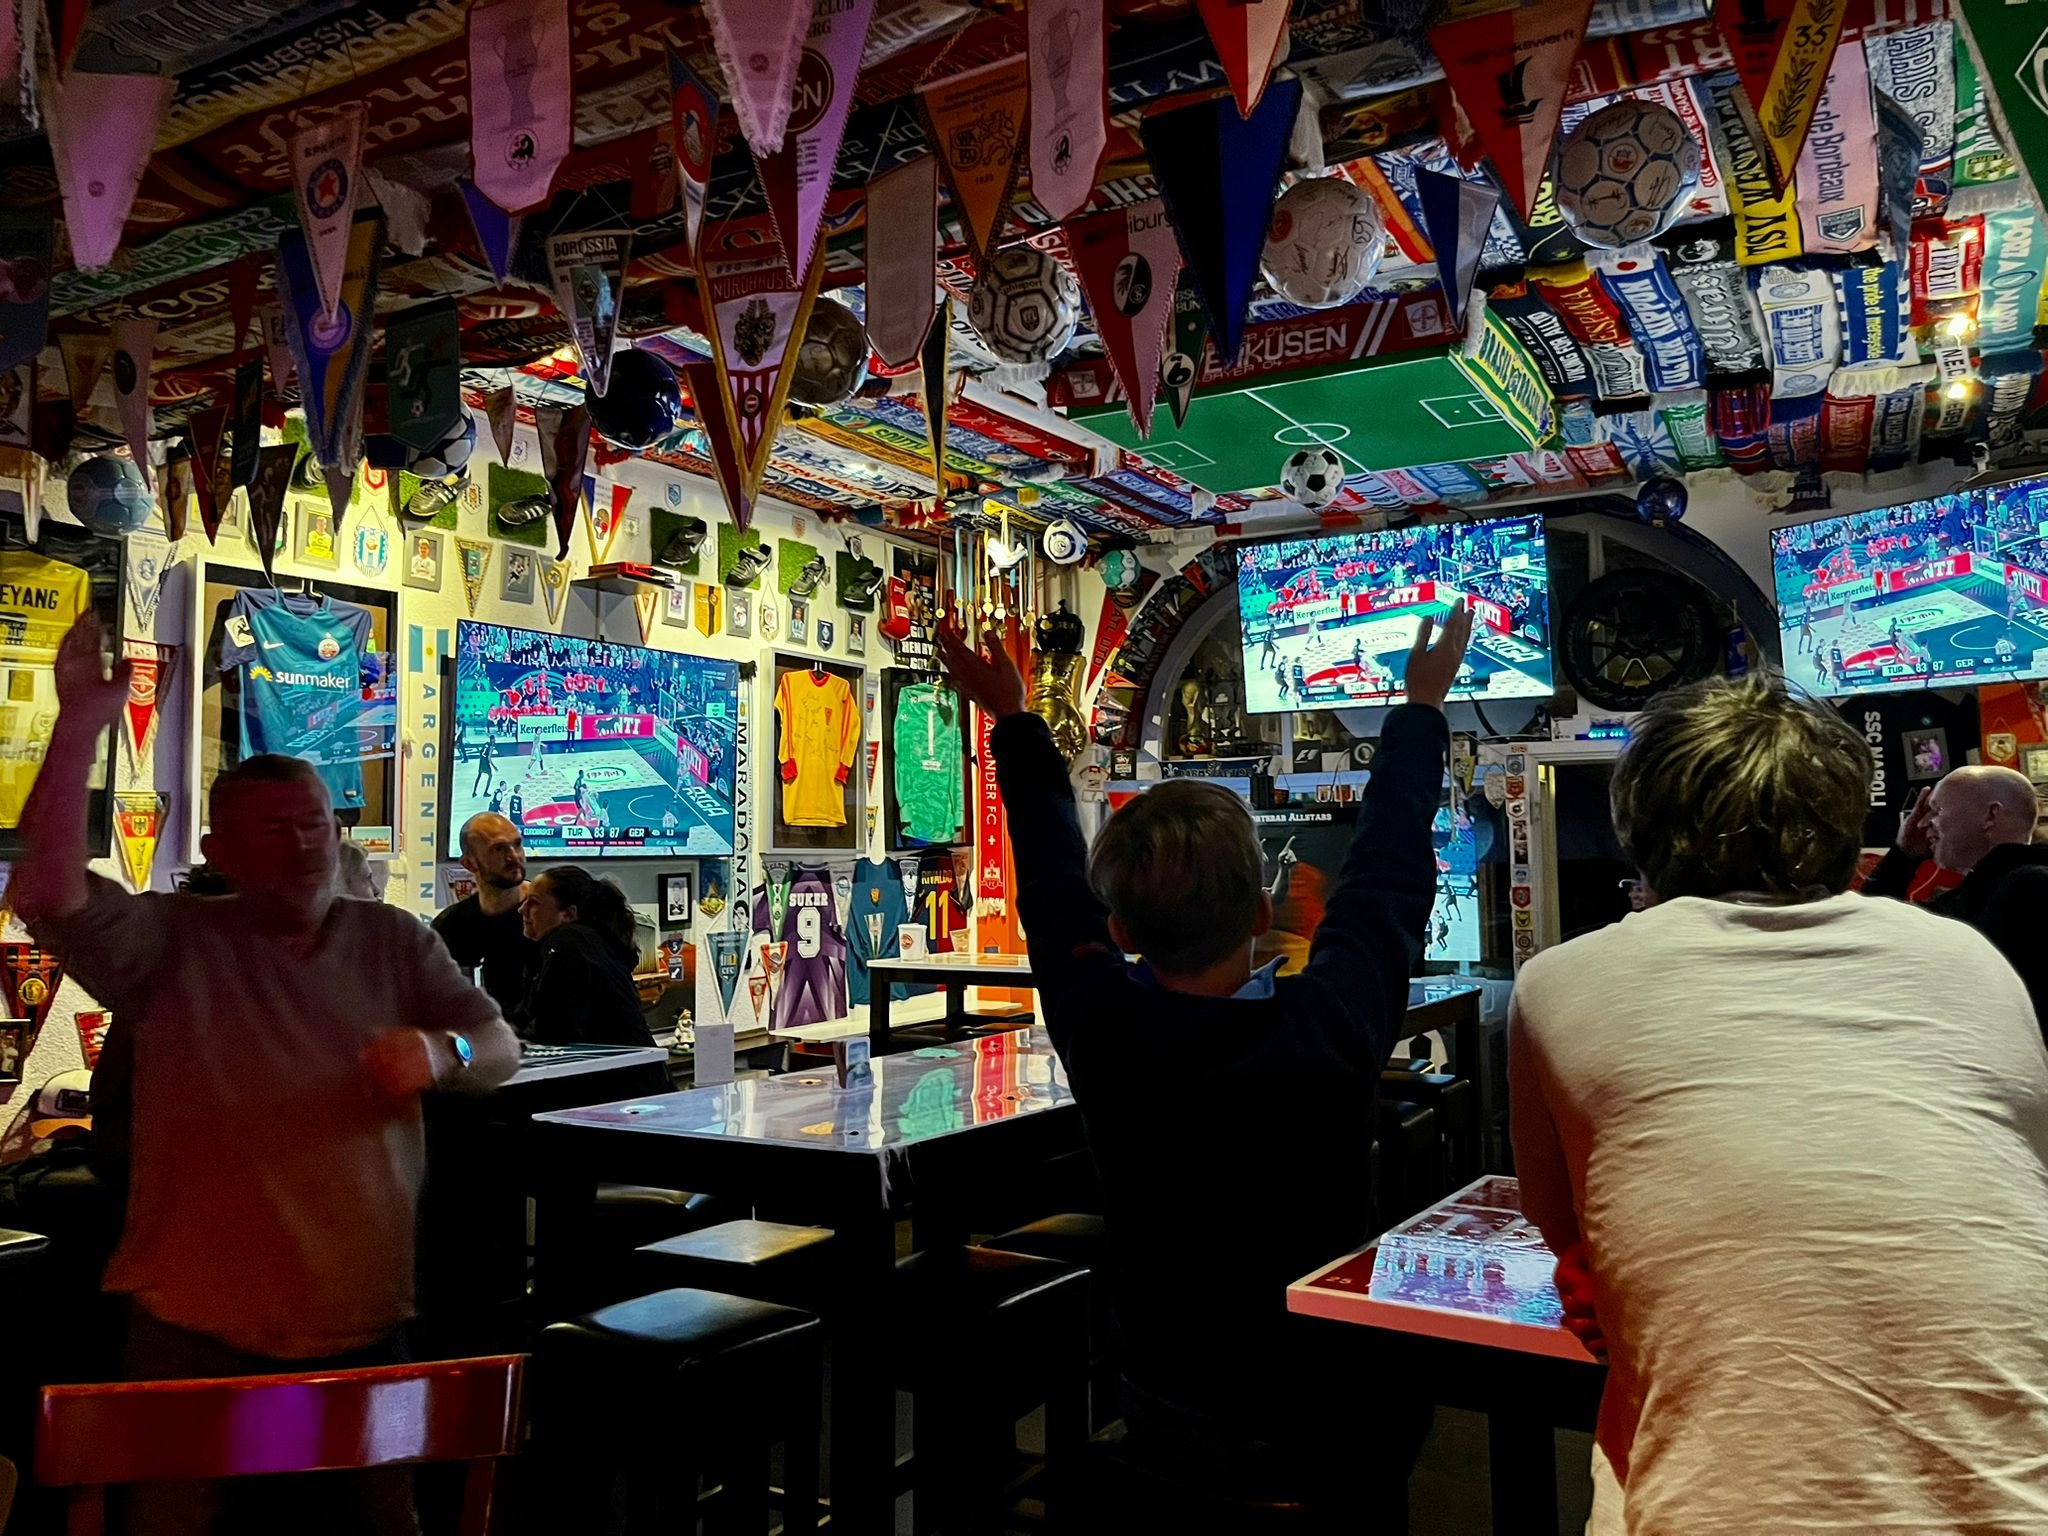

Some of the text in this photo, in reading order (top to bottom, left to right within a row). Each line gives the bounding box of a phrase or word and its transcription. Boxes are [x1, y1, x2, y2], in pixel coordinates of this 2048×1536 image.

[1811, 134, 1846, 204] Bordeaux
[554, 236, 618, 258] BORUSSIA
[1746, 213, 1788, 258] TSV
[1862, 265, 1885, 283] the
[1617, 278, 1674, 340] NIPPON
[1858, 284, 1885, 310] pride
[1548, 335, 1576, 356] FOR
[1864, 318, 1885, 360] merseyside
[1559, 353, 1588, 383] VIKING
[1652, 337, 1695, 384] ULTRA
[901, 640, 934, 656] HENRY
[1887, 665, 1904, 675] TUR
[1915, 661, 1928, 673] 83
[1932, 660, 1944, 672] 87
[1955, 658, 1974, 669] GER
[275, 671, 352, 690] sunmaker
[1863, 710, 1888, 807] SSC NAPOLI
[735, 722, 749, 898] MARADONA
[985, 805, 998, 826] FC
[1288, 811, 1333, 824] ALLSTARS
[567, 827, 584, 838] TUR
[593, 826, 605, 838] 83
[609, 826, 620, 838] 87
[628, 827, 646, 838] GER
[789, 892, 829, 908] SUKER
[925, 889, 950, 941] 11
[796, 906, 822, 959] 9
